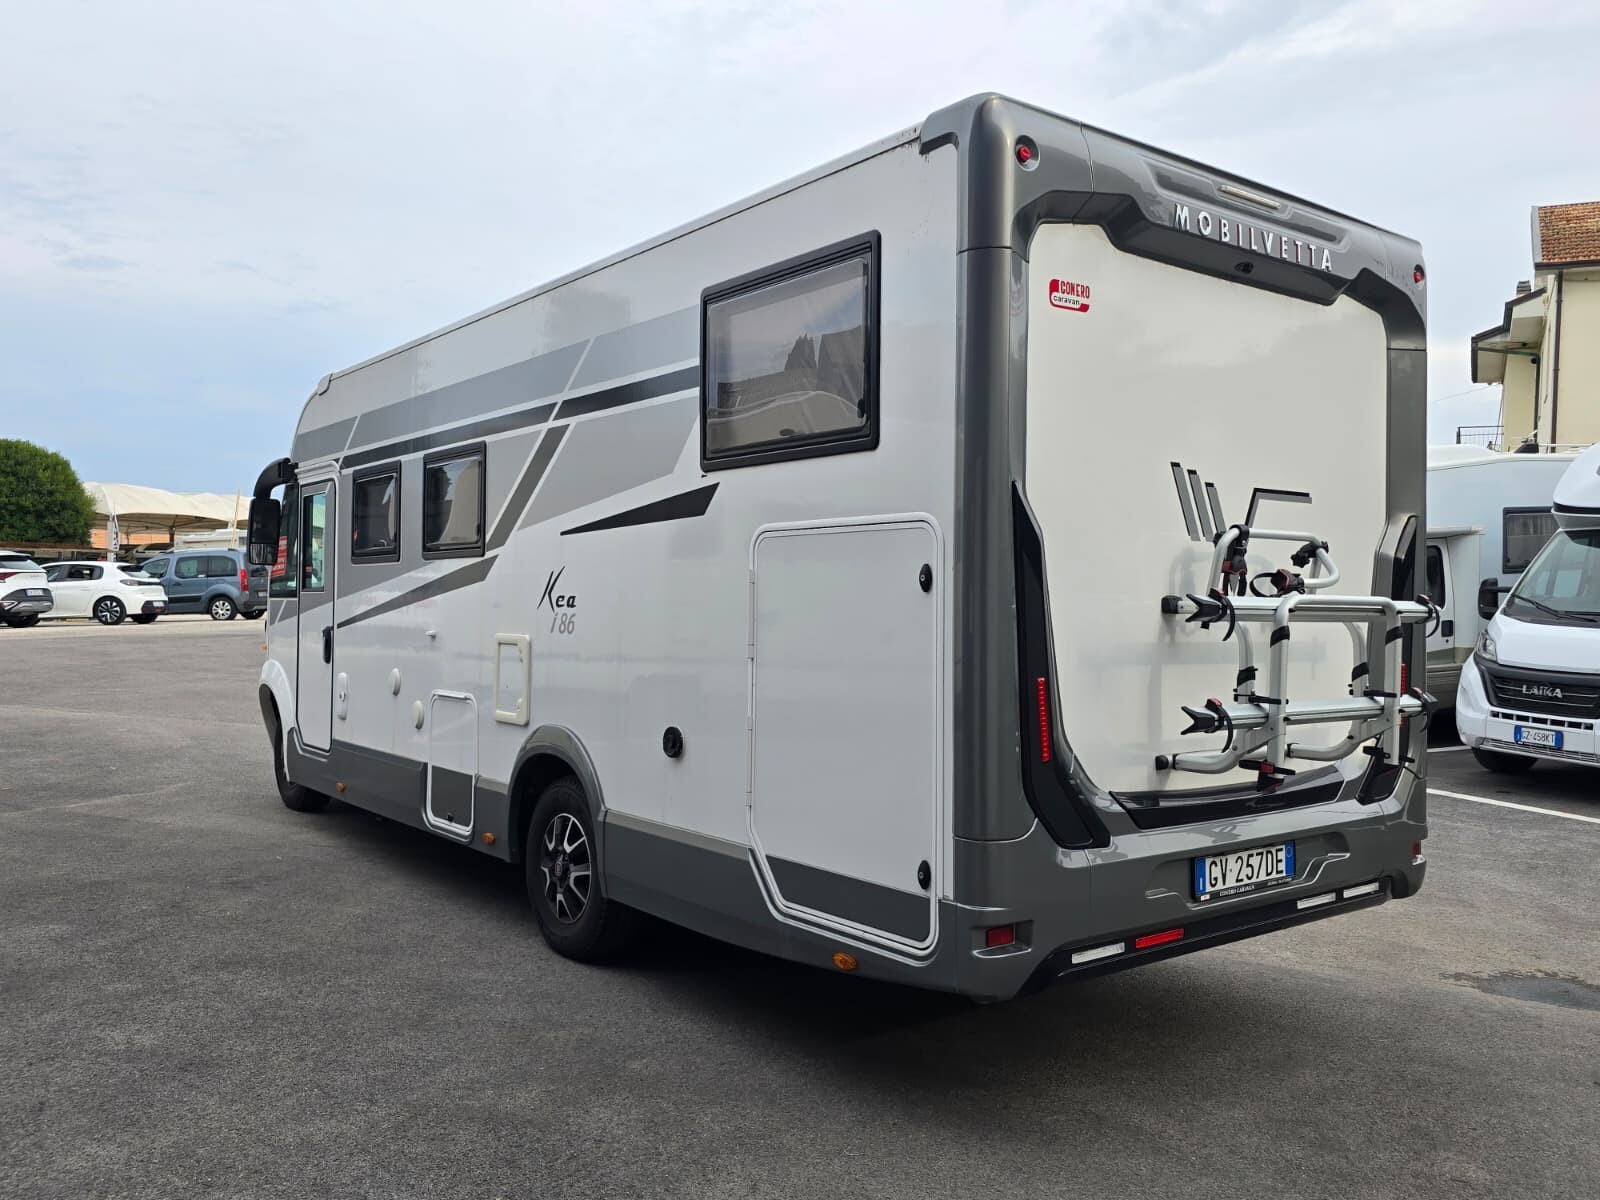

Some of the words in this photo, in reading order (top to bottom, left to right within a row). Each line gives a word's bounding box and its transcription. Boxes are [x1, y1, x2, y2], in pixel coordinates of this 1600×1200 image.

[1174, 203, 1333, 272] MOBILVETTA
[1060, 280, 1090, 299] CONERO
[1053, 295, 1080, 305] caravan
[537, 565, 577, 613] Kea
[1522, 684, 1563, 698] LAIKA
